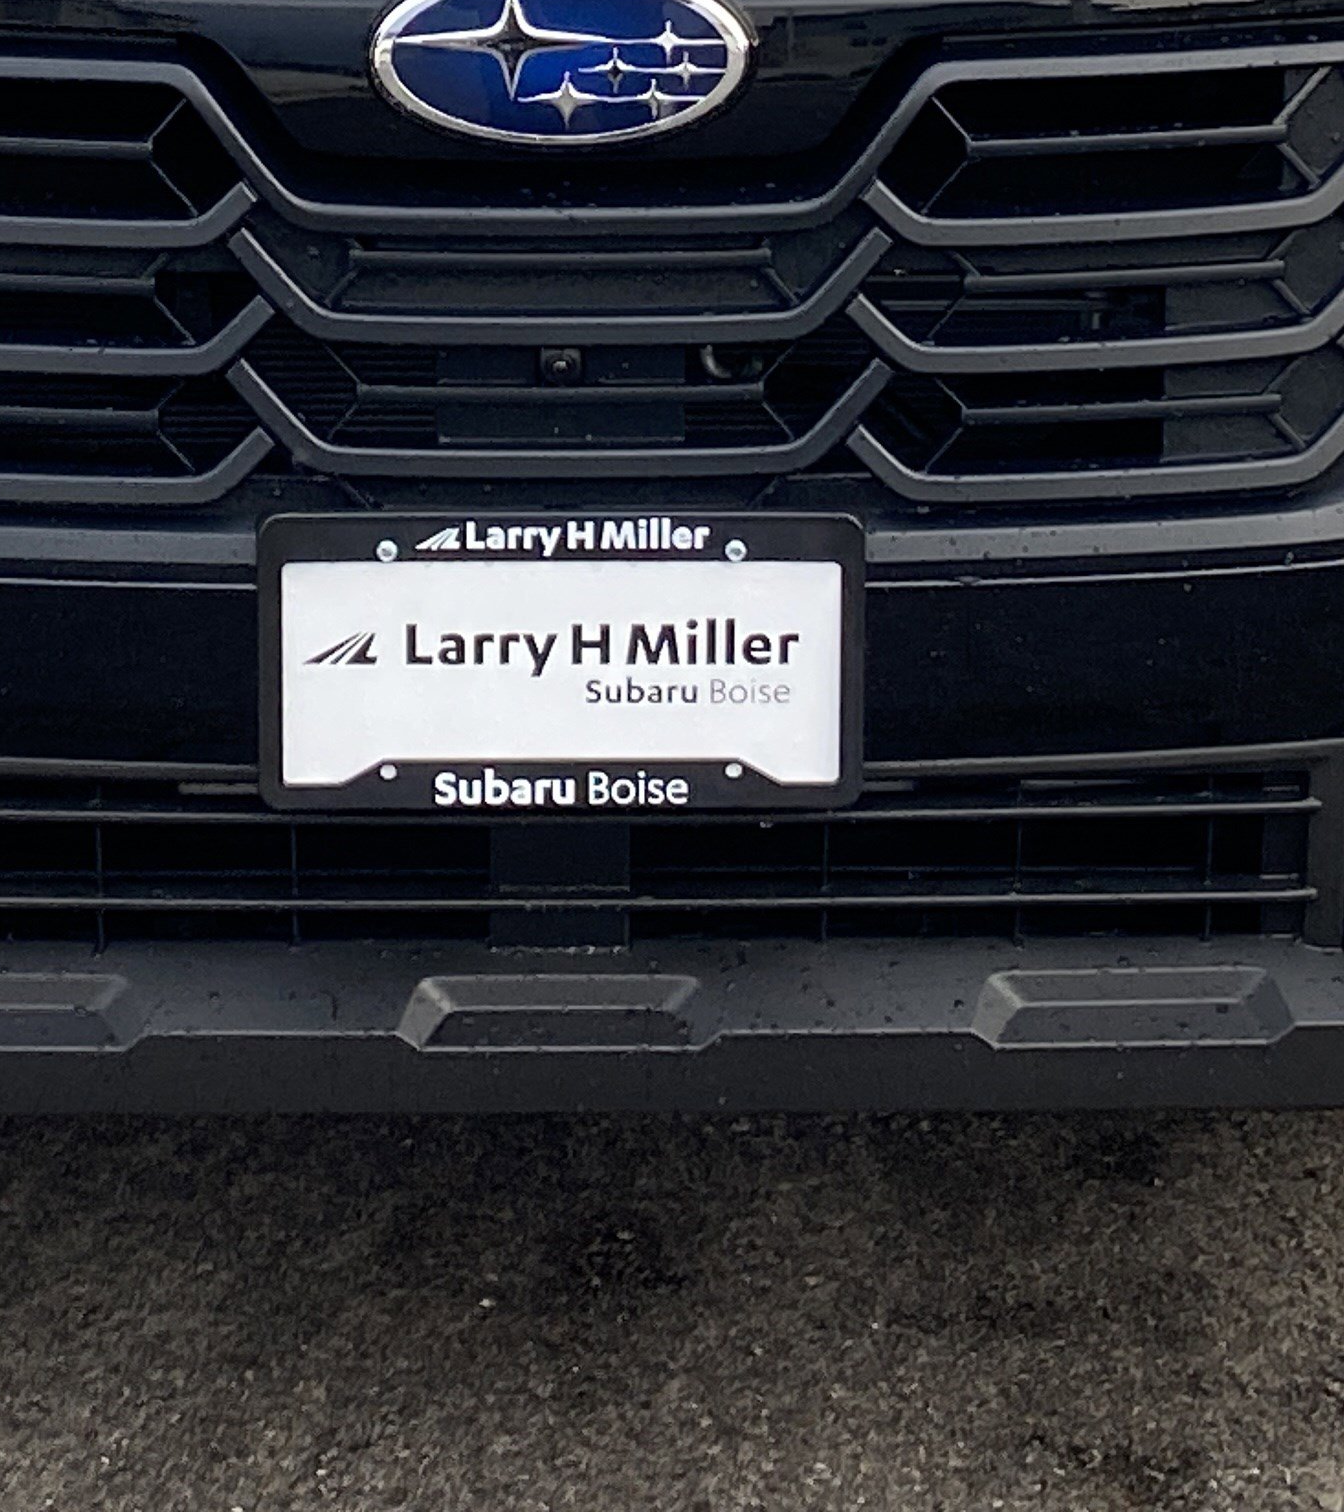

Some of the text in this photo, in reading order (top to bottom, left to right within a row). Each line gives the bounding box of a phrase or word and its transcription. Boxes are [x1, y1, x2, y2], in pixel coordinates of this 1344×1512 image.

[465, 517, 710, 557] Larry H Miller
[405, 618, 799, 677] Larry H Miller
[585, 677, 791, 704] Subaru Boise
[434, 768, 689, 806] Subaru Boise
